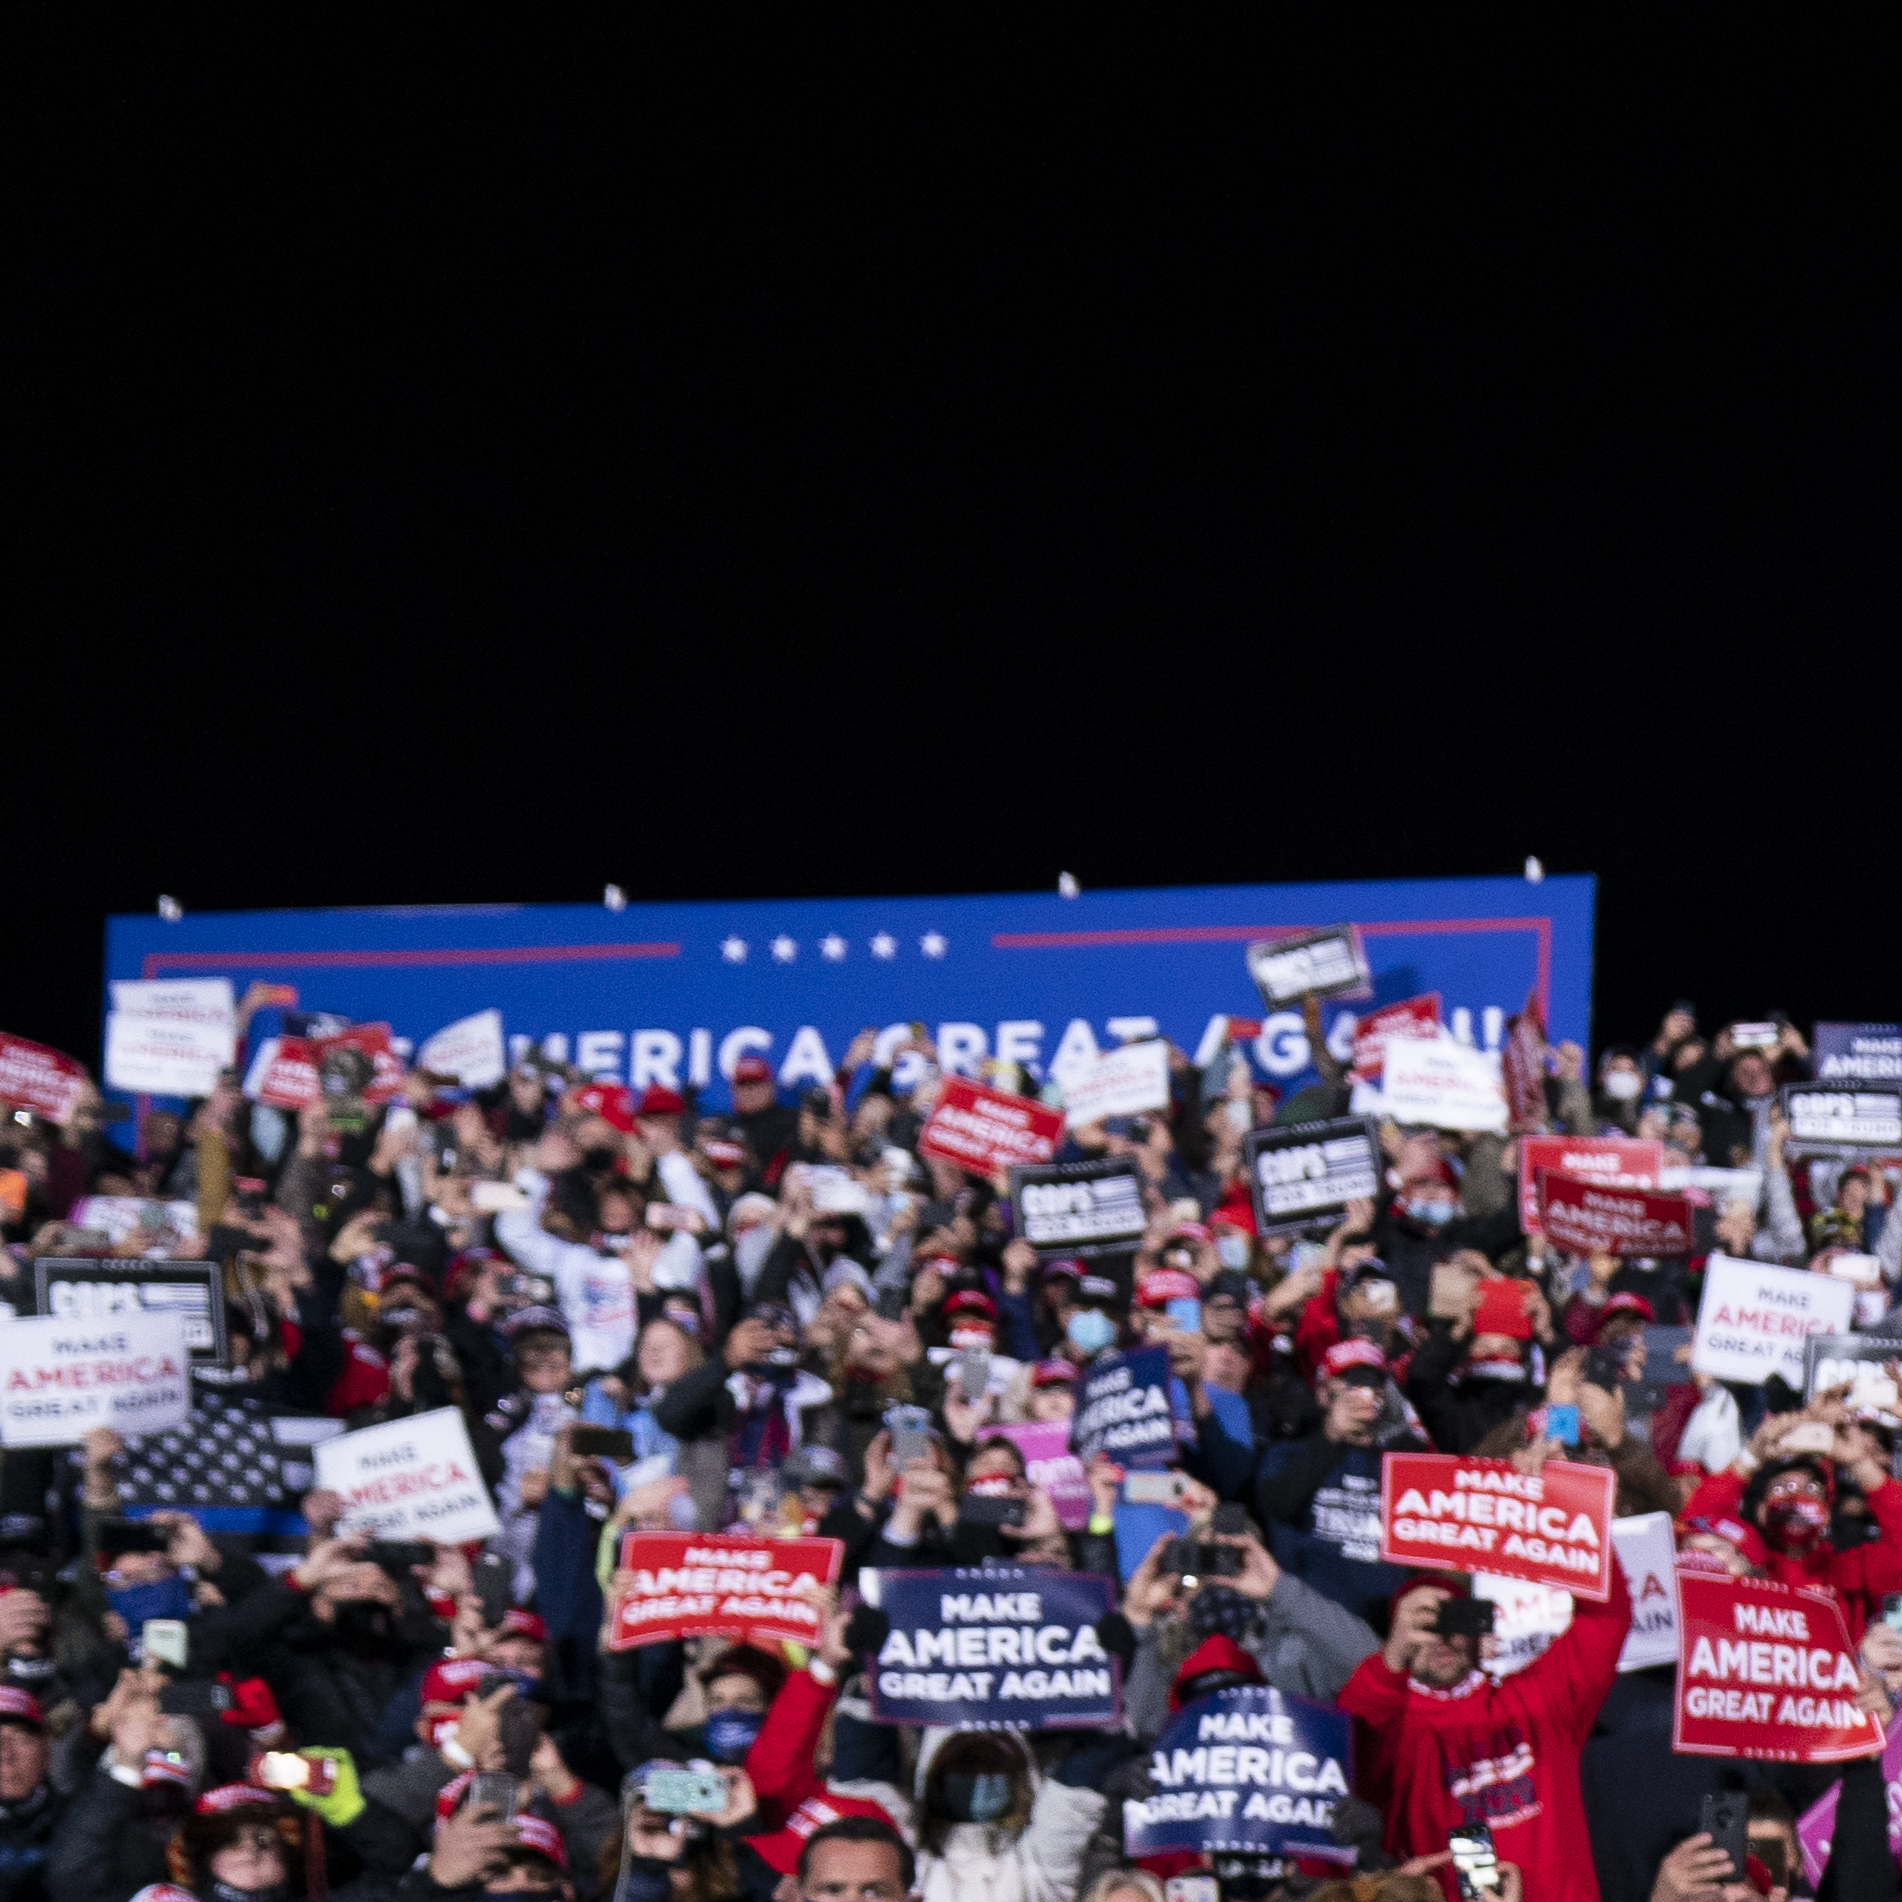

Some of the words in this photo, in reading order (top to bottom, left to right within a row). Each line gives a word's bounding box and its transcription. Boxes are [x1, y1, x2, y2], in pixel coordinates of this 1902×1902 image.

[1789, 1092, 1857, 1120] COPS
[1544, 1198, 1687, 1241] AMERICA
[1756, 1286, 1809, 1309] MAKE
[1706, 1337, 1778, 1363] GREAT
[6, 1355, 182, 1393] AMERICA
[1454, 1469, 1545, 1501] MAKE
[1394, 1487, 1600, 1548] AMERICA
[683, 1546, 773, 1570] MAKE
[1392, 1517, 1499, 1552] GREAT
[1501, 1533, 1600, 1576] AGAIN
[633, 1567, 819, 1598] AMERICA
[621, 1595, 720, 1626] GREAT
[719, 1596, 819, 1624] AGAIN
[940, 1592, 1044, 1622] MAKE
[1732, 1601, 1812, 1642] MAKE
[878, 1623, 1109, 1668] AMERICA
[1688, 1634, 1861, 1691] AMERICA
[878, 1670, 995, 1701] GREAT
[998, 1668, 1112, 1701] AGAIN
[1685, 1685, 1776, 1725] GREAT
[1775, 1694, 1867, 1730] AGAIN
[1199, 1711, 1297, 1745] MAKE
[1147, 1744, 1351, 1797] AMERICA
